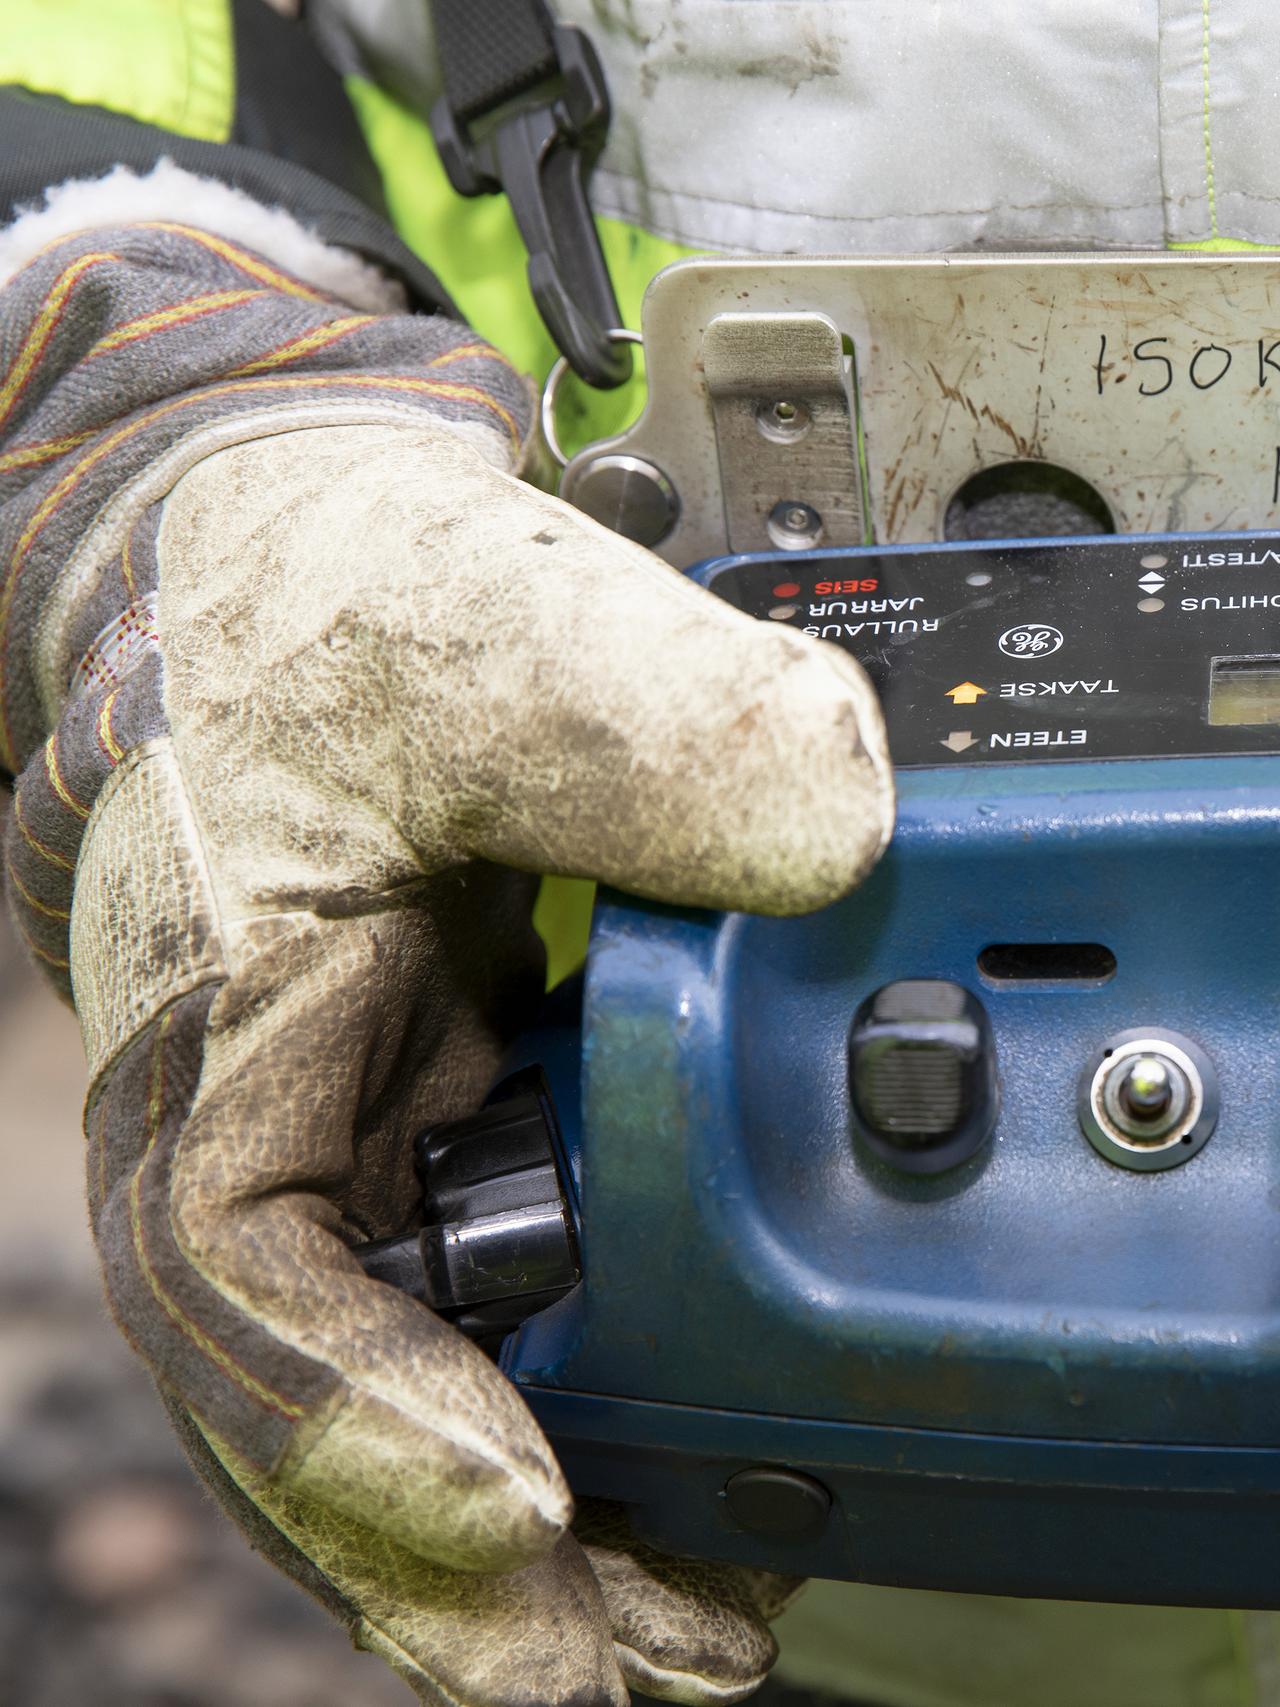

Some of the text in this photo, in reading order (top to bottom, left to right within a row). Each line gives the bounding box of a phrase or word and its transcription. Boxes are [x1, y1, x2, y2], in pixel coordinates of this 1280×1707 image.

[815, 578, 878, 595] SEIS
[809, 597, 924, 618] JARRUR
[801, 618, 939, 639] RULLAUS
[1000, 680, 1119, 697] TAAKSE
[989, 729, 1087, 748] ETEEN
